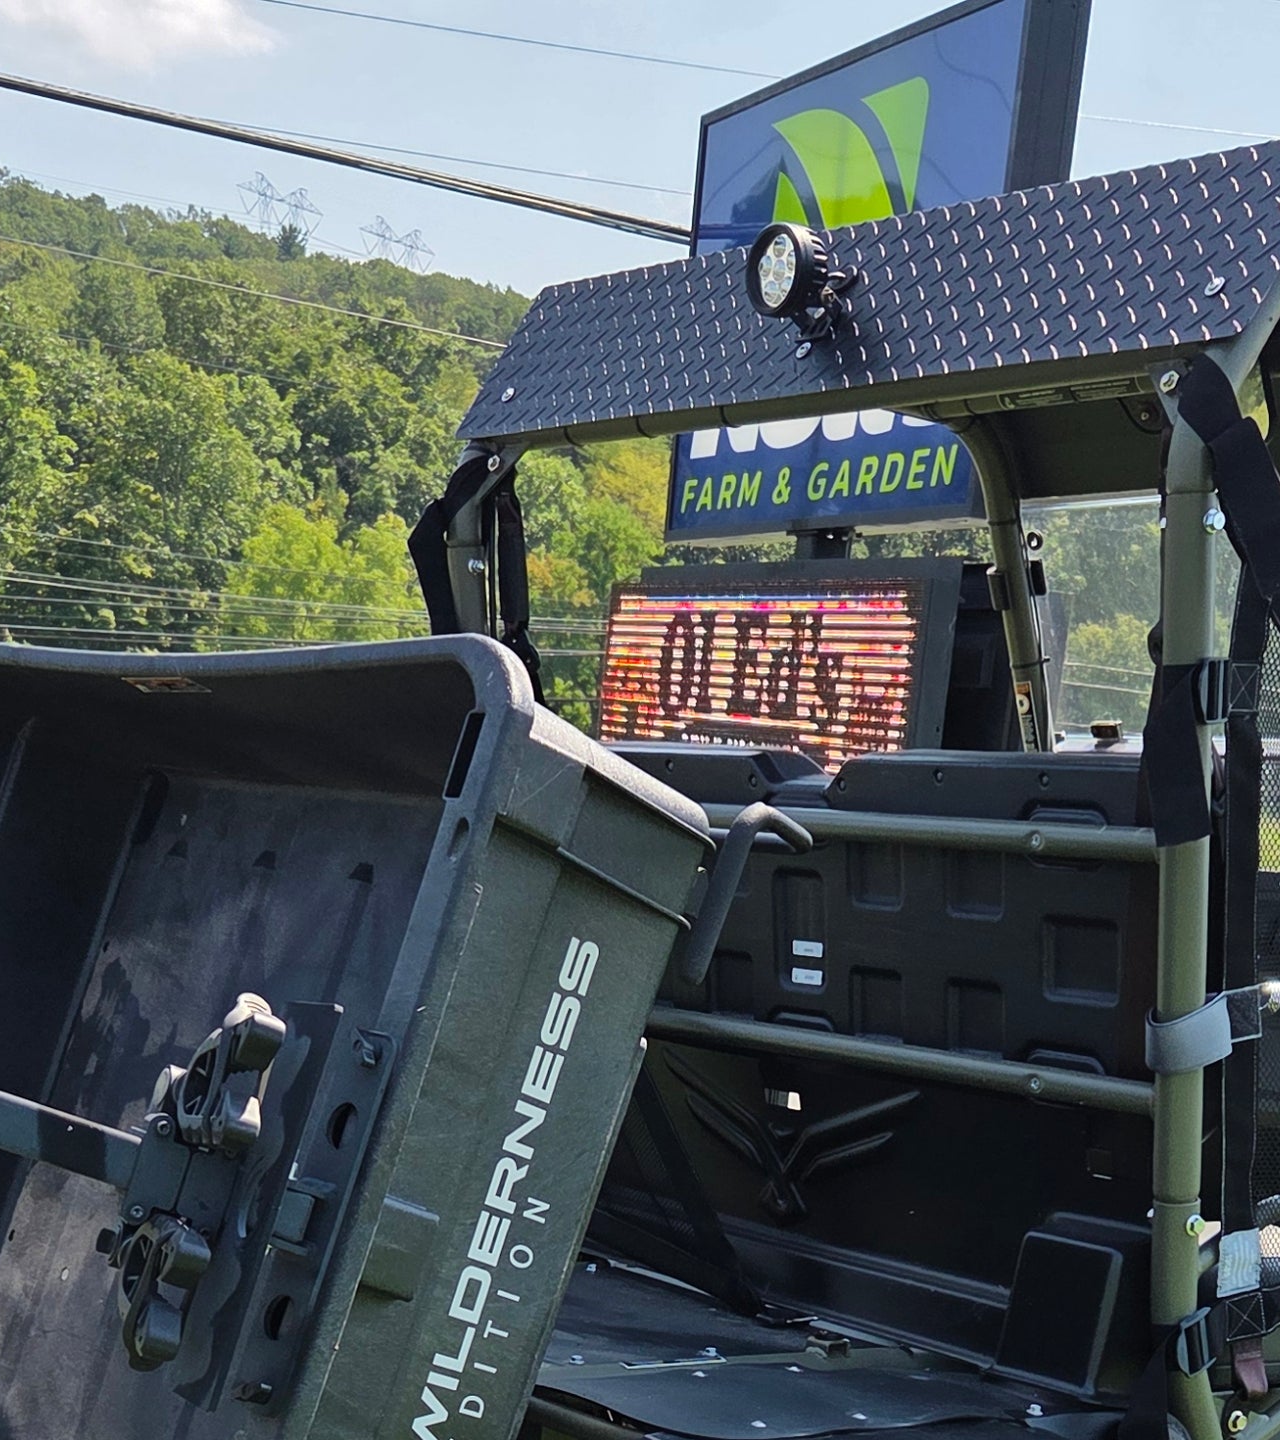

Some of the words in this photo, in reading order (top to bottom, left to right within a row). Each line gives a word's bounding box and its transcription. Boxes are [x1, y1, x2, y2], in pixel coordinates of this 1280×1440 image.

[680, 470, 762, 514] FARM
[771, 466, 791, 505] &
[807, 444, 959, 501] GARDEN
